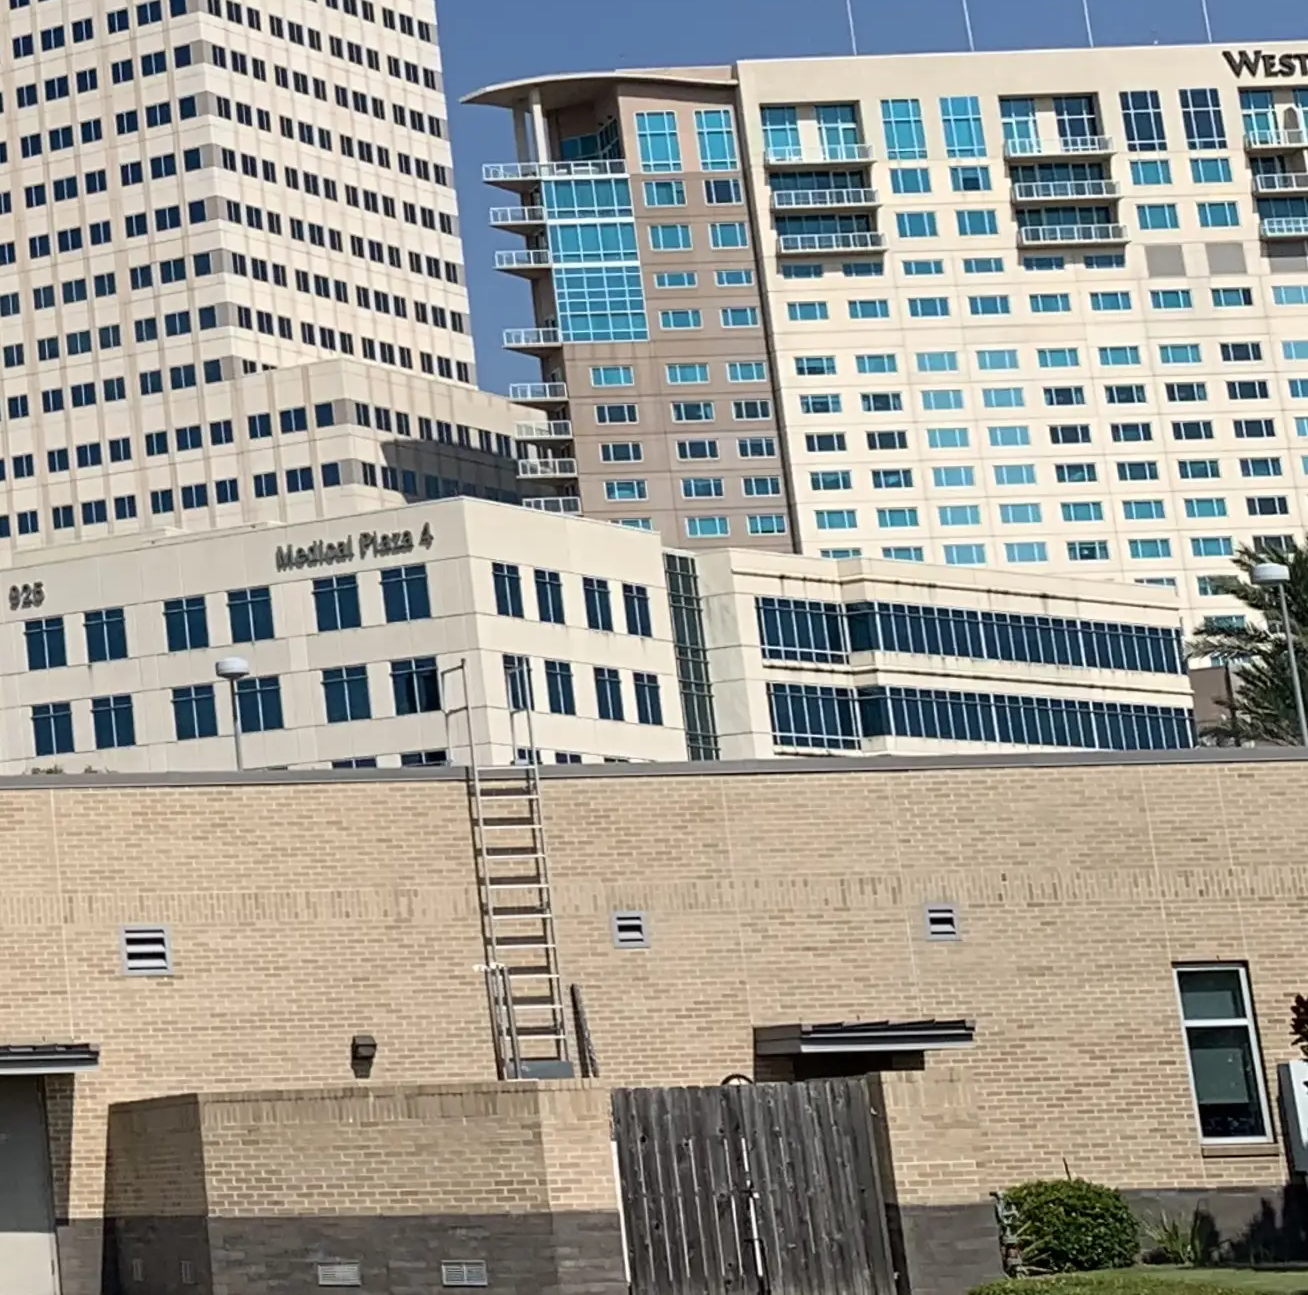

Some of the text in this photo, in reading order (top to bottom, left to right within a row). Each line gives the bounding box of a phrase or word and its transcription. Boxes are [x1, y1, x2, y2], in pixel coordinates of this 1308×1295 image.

[275, 521, 434, 572] Medical Plaza 4
[8, 581, 45, 610] 925
